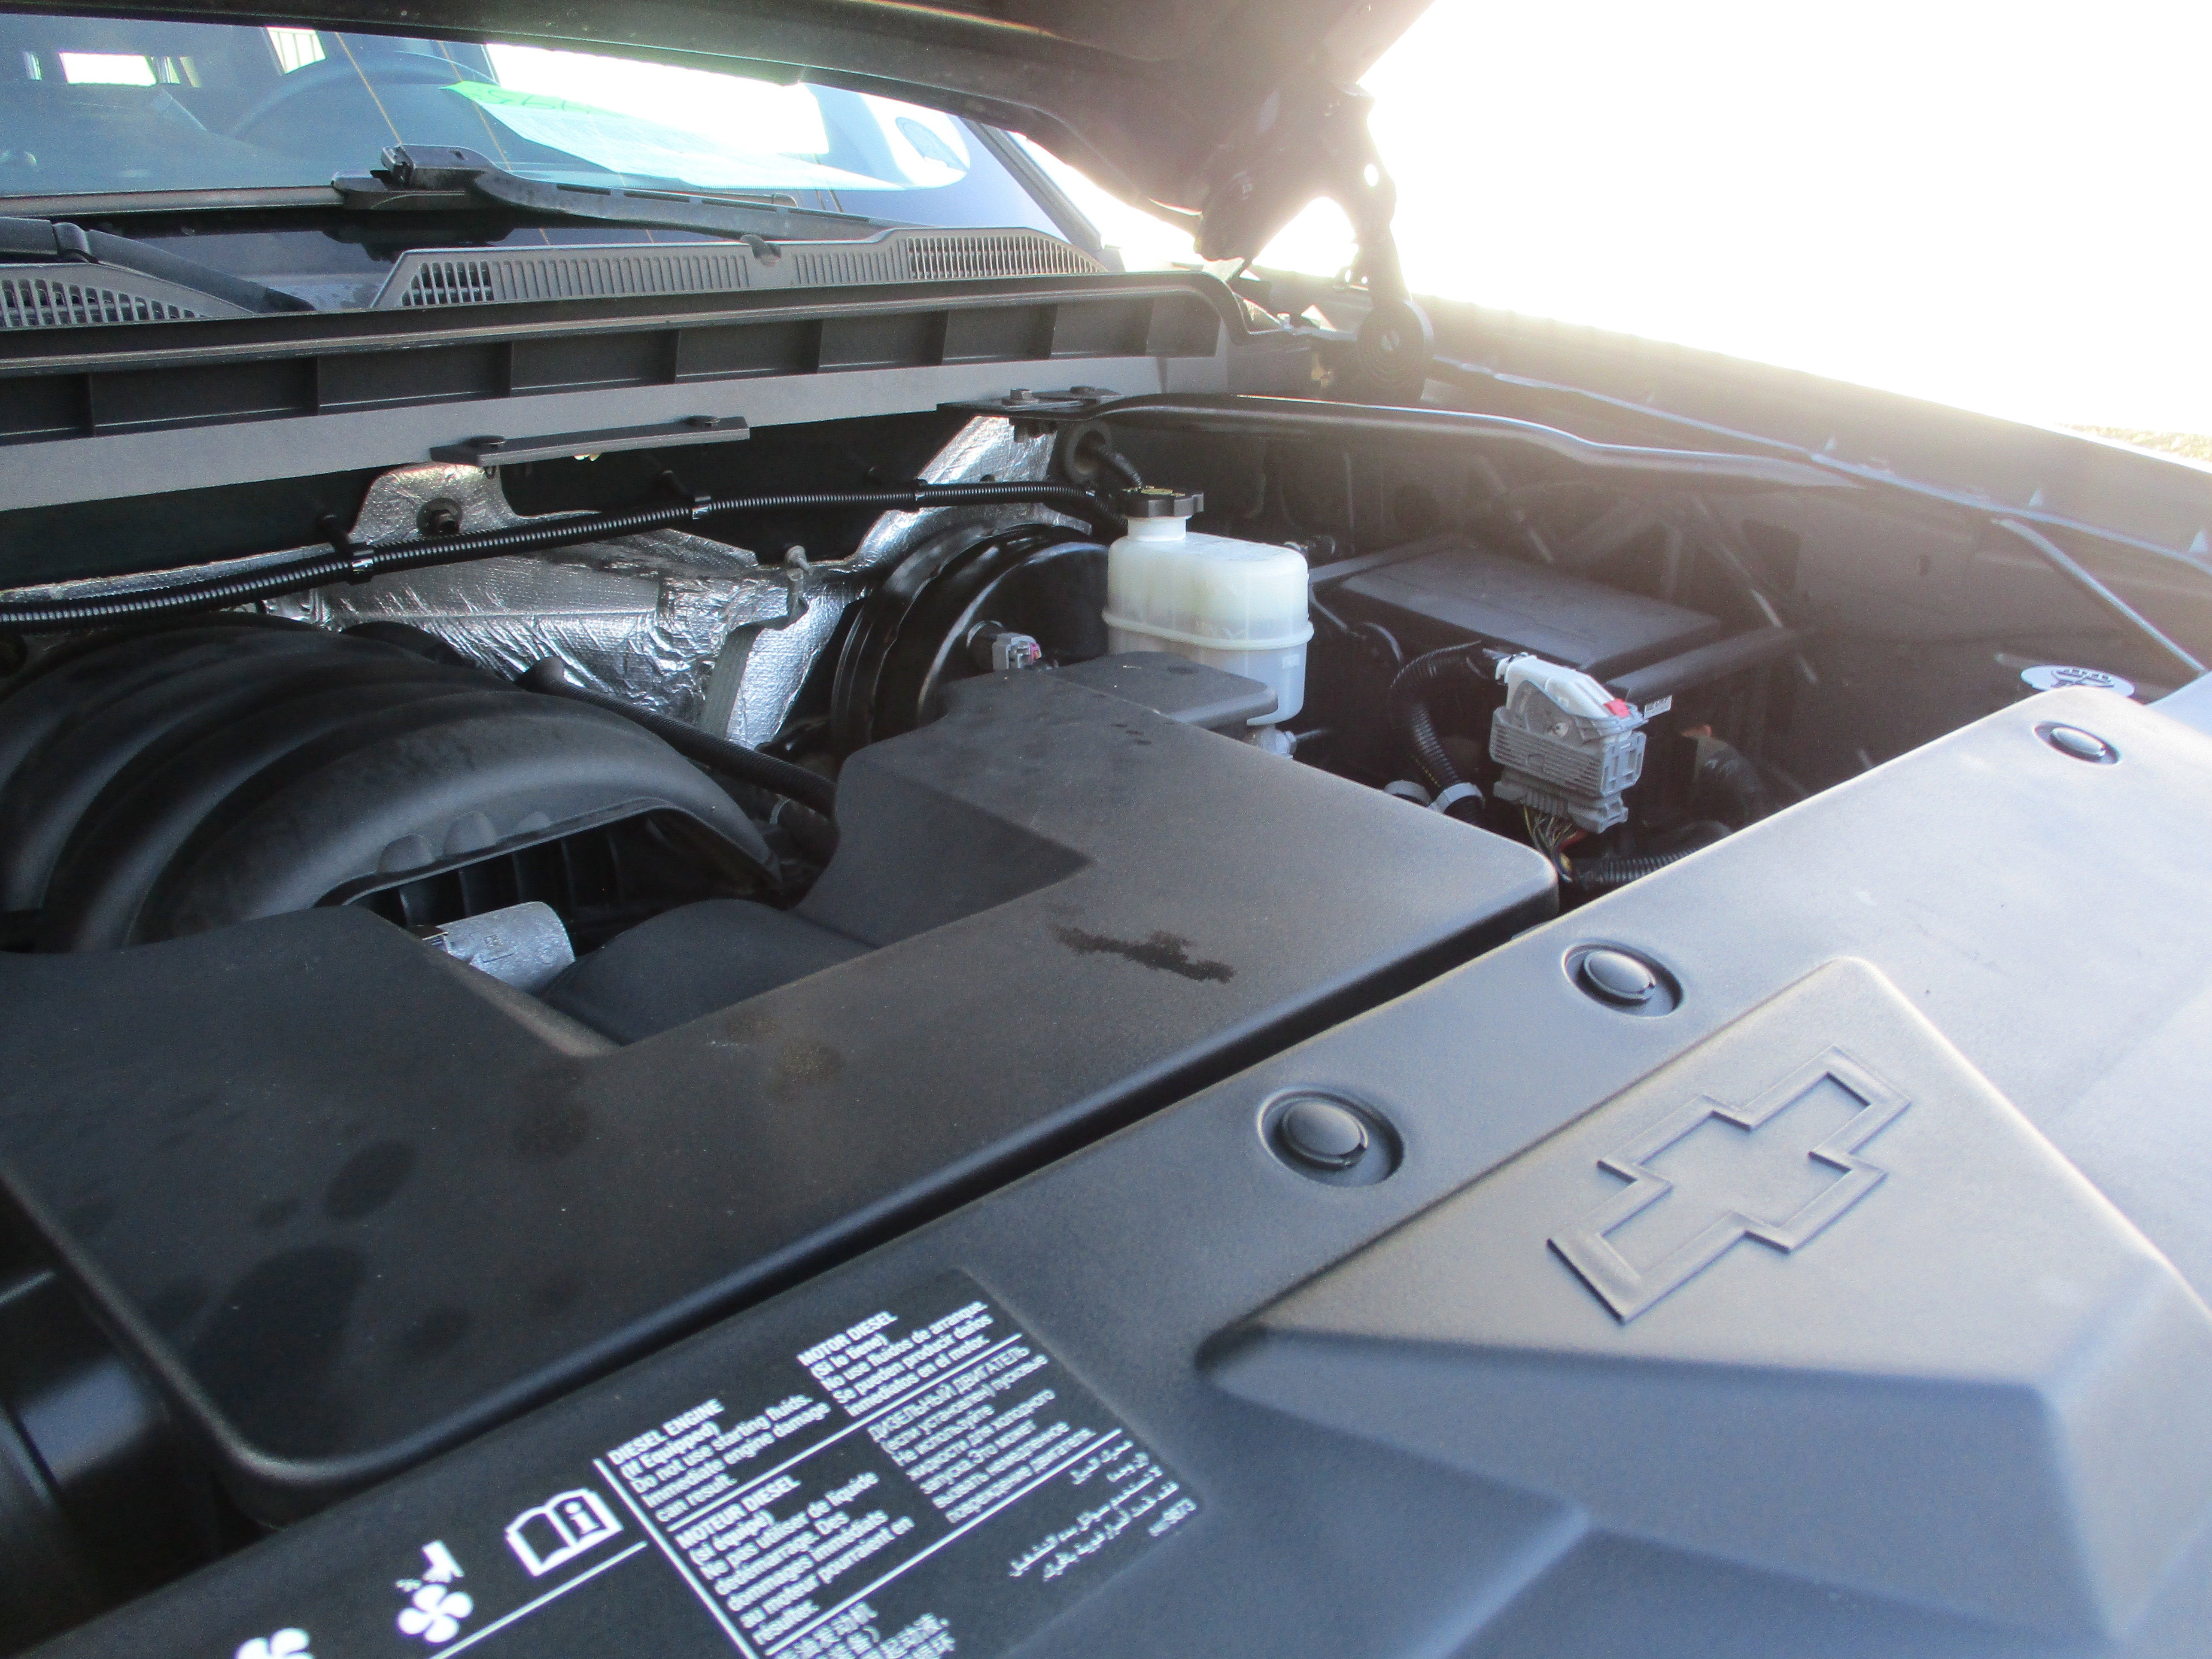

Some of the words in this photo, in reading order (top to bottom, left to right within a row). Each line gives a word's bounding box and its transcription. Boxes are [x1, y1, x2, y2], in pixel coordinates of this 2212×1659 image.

[797, 1334, 851, 1366] MOTOR
[846, 1312, 898, 1340] DIESEL
[820, 1375, 845, 1393] No
[843, 1361, 871, 1380] use
[867, 1338, 915, 1366] fluidos
[911, 1329, 931, 1343] de
[833, 1388, 857, 1403] Se
[854, 1362, 905, 1395] pueden
[902, 1334, 955, 1369] producir
[917, 1363, 938, 1377] en
[935, 1353, 951, 1367] el
[608, 1430, 668, 1465] DIESEL
[663, 1399, 724, 1436] ENGINE
[630, 1475, 658, 1493] Do
[655, 1459, 687, 1480] not
[682, 1445, 714, 1466] use
[711, 1416, 771, 1450] starting
[641, 1459, 726, 1507] Immediate
[723, 1432, 775, 1464] engine
[772, 1402, 830, 1437] damage
[656, 1499, 689, 1522] can
[675, 1504, 747, 1549] MOTEUR
[741, 1475, 801, 1511] DIESEL
[699, 1559, 729, 1581] Ne
[726, 1542, 759, 1570] pas
[754, 1512, 809, 1548] utiliser
[807, 1500, 831, 1523] de
[825, 1472, 879, 1506] liquide
[814, 1511, 854, 1534] Des
[727, 1555, 814, 1611] dommages
[740, 1607, 766, 1628] au
[762, 1574, 819, 1614] moteur
[817, 1527, 895, 1583] pourraient
[891, 1516, 914, 1534] en
